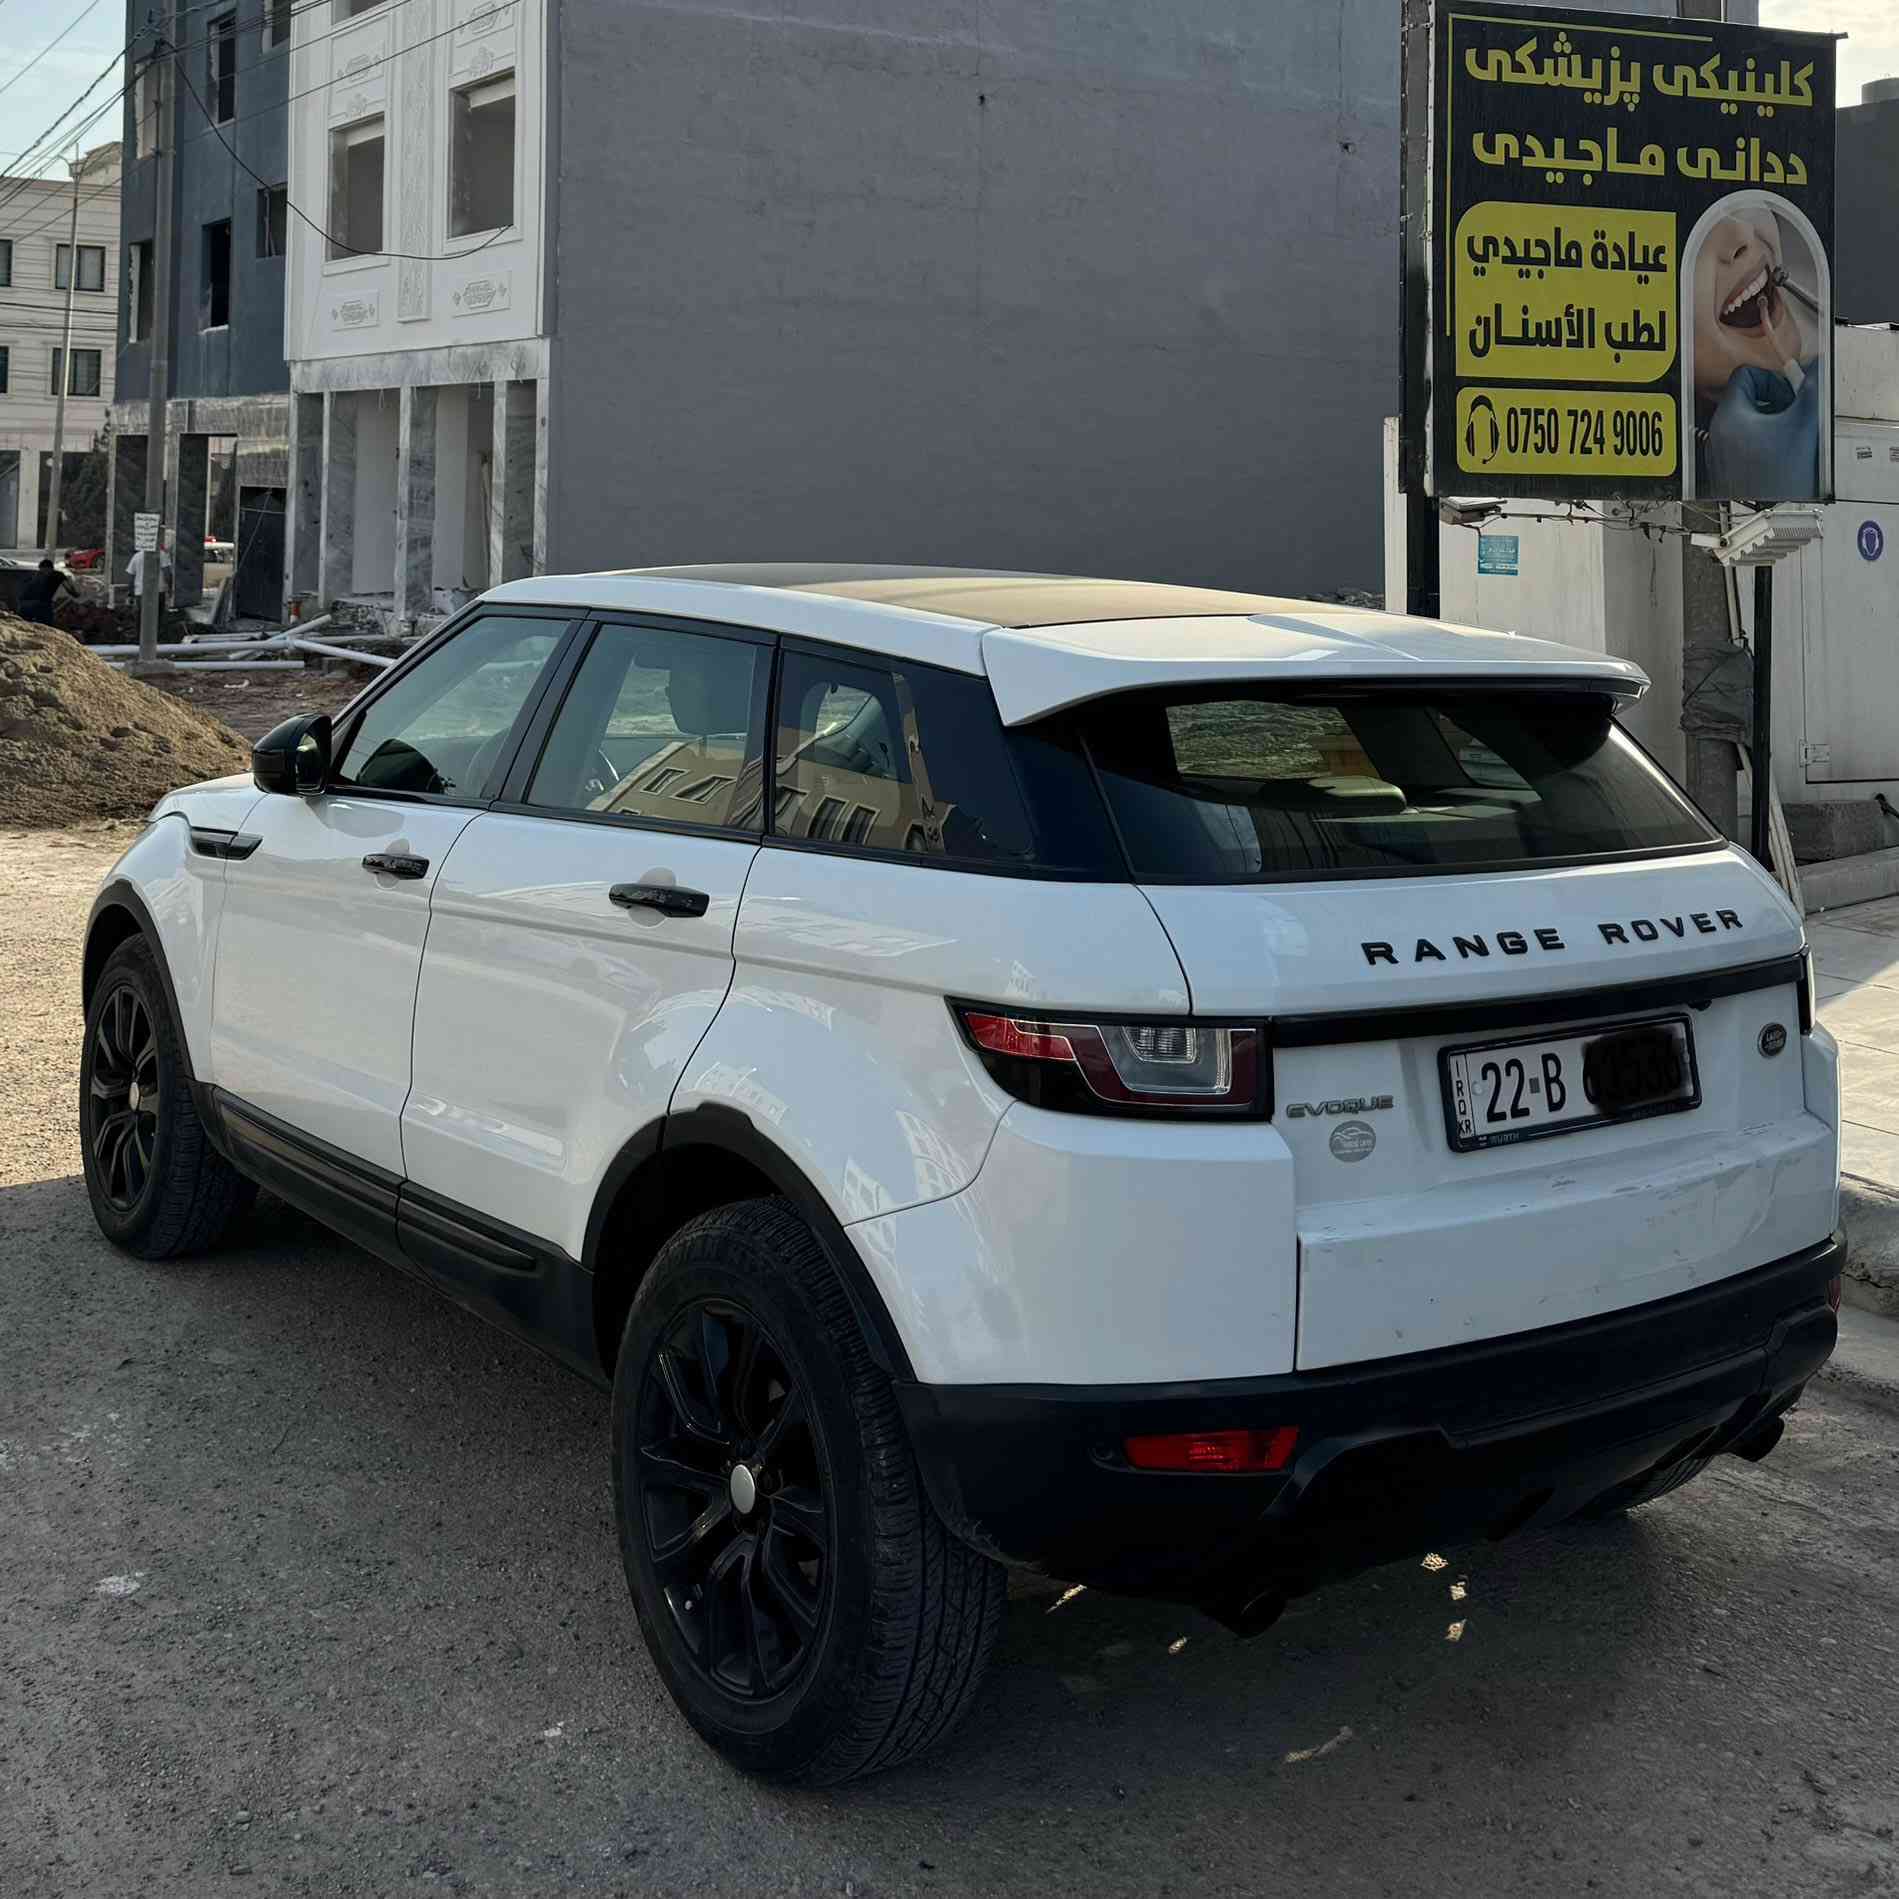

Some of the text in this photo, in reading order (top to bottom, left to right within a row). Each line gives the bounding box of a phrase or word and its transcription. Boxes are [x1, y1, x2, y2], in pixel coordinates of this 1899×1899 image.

[1591, 230, 1668, 285] عيادة
[1604, 308, 1667, 363] لطب
[1506, 407, 1664, 457] 0750 724 9006
[1361, 908, 1744, 966] RANGE ROVER
[1286, 1095, 1394, 1118] EVOQUE
